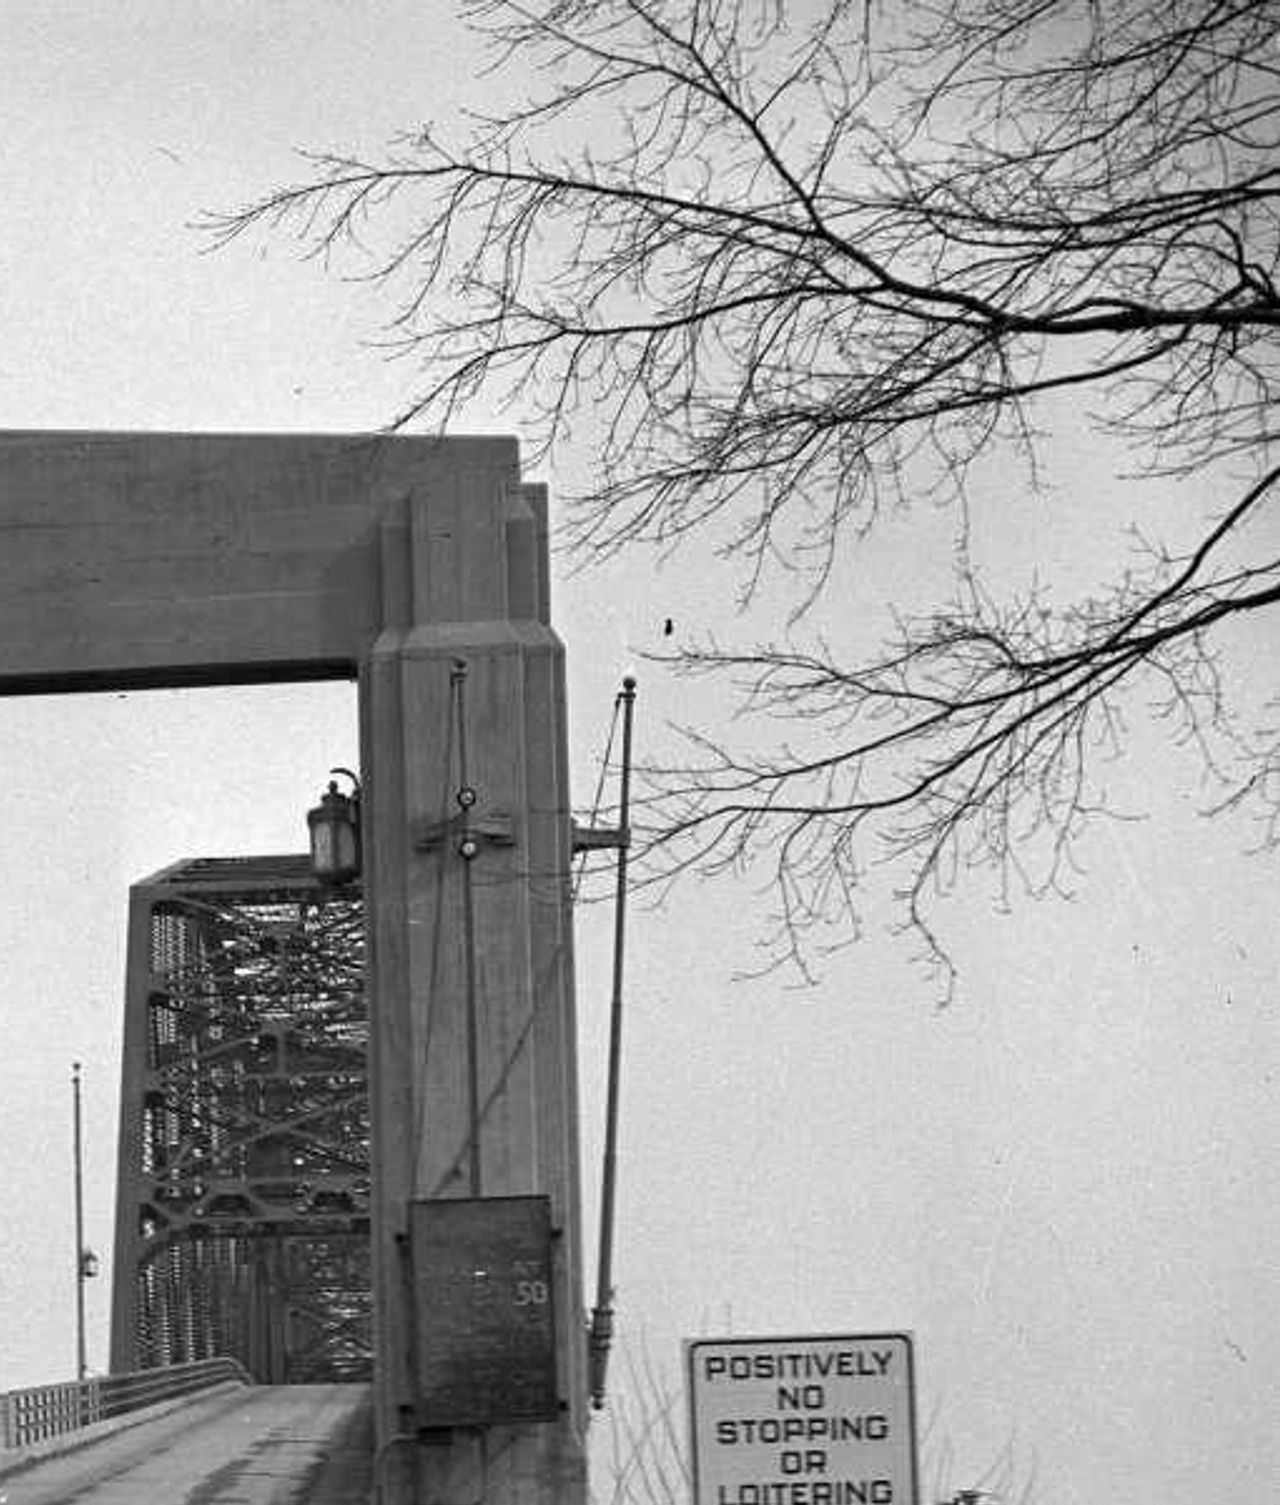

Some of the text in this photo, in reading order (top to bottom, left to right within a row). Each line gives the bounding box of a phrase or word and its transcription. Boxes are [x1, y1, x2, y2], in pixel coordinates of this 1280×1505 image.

[705, 1351, 892, 1381] POSITIVELY
[777, 1384, 825, 1410] NO
[715, 1415, 890, 1445] STOPPING
[780, 1450, 827, 1475] OR
